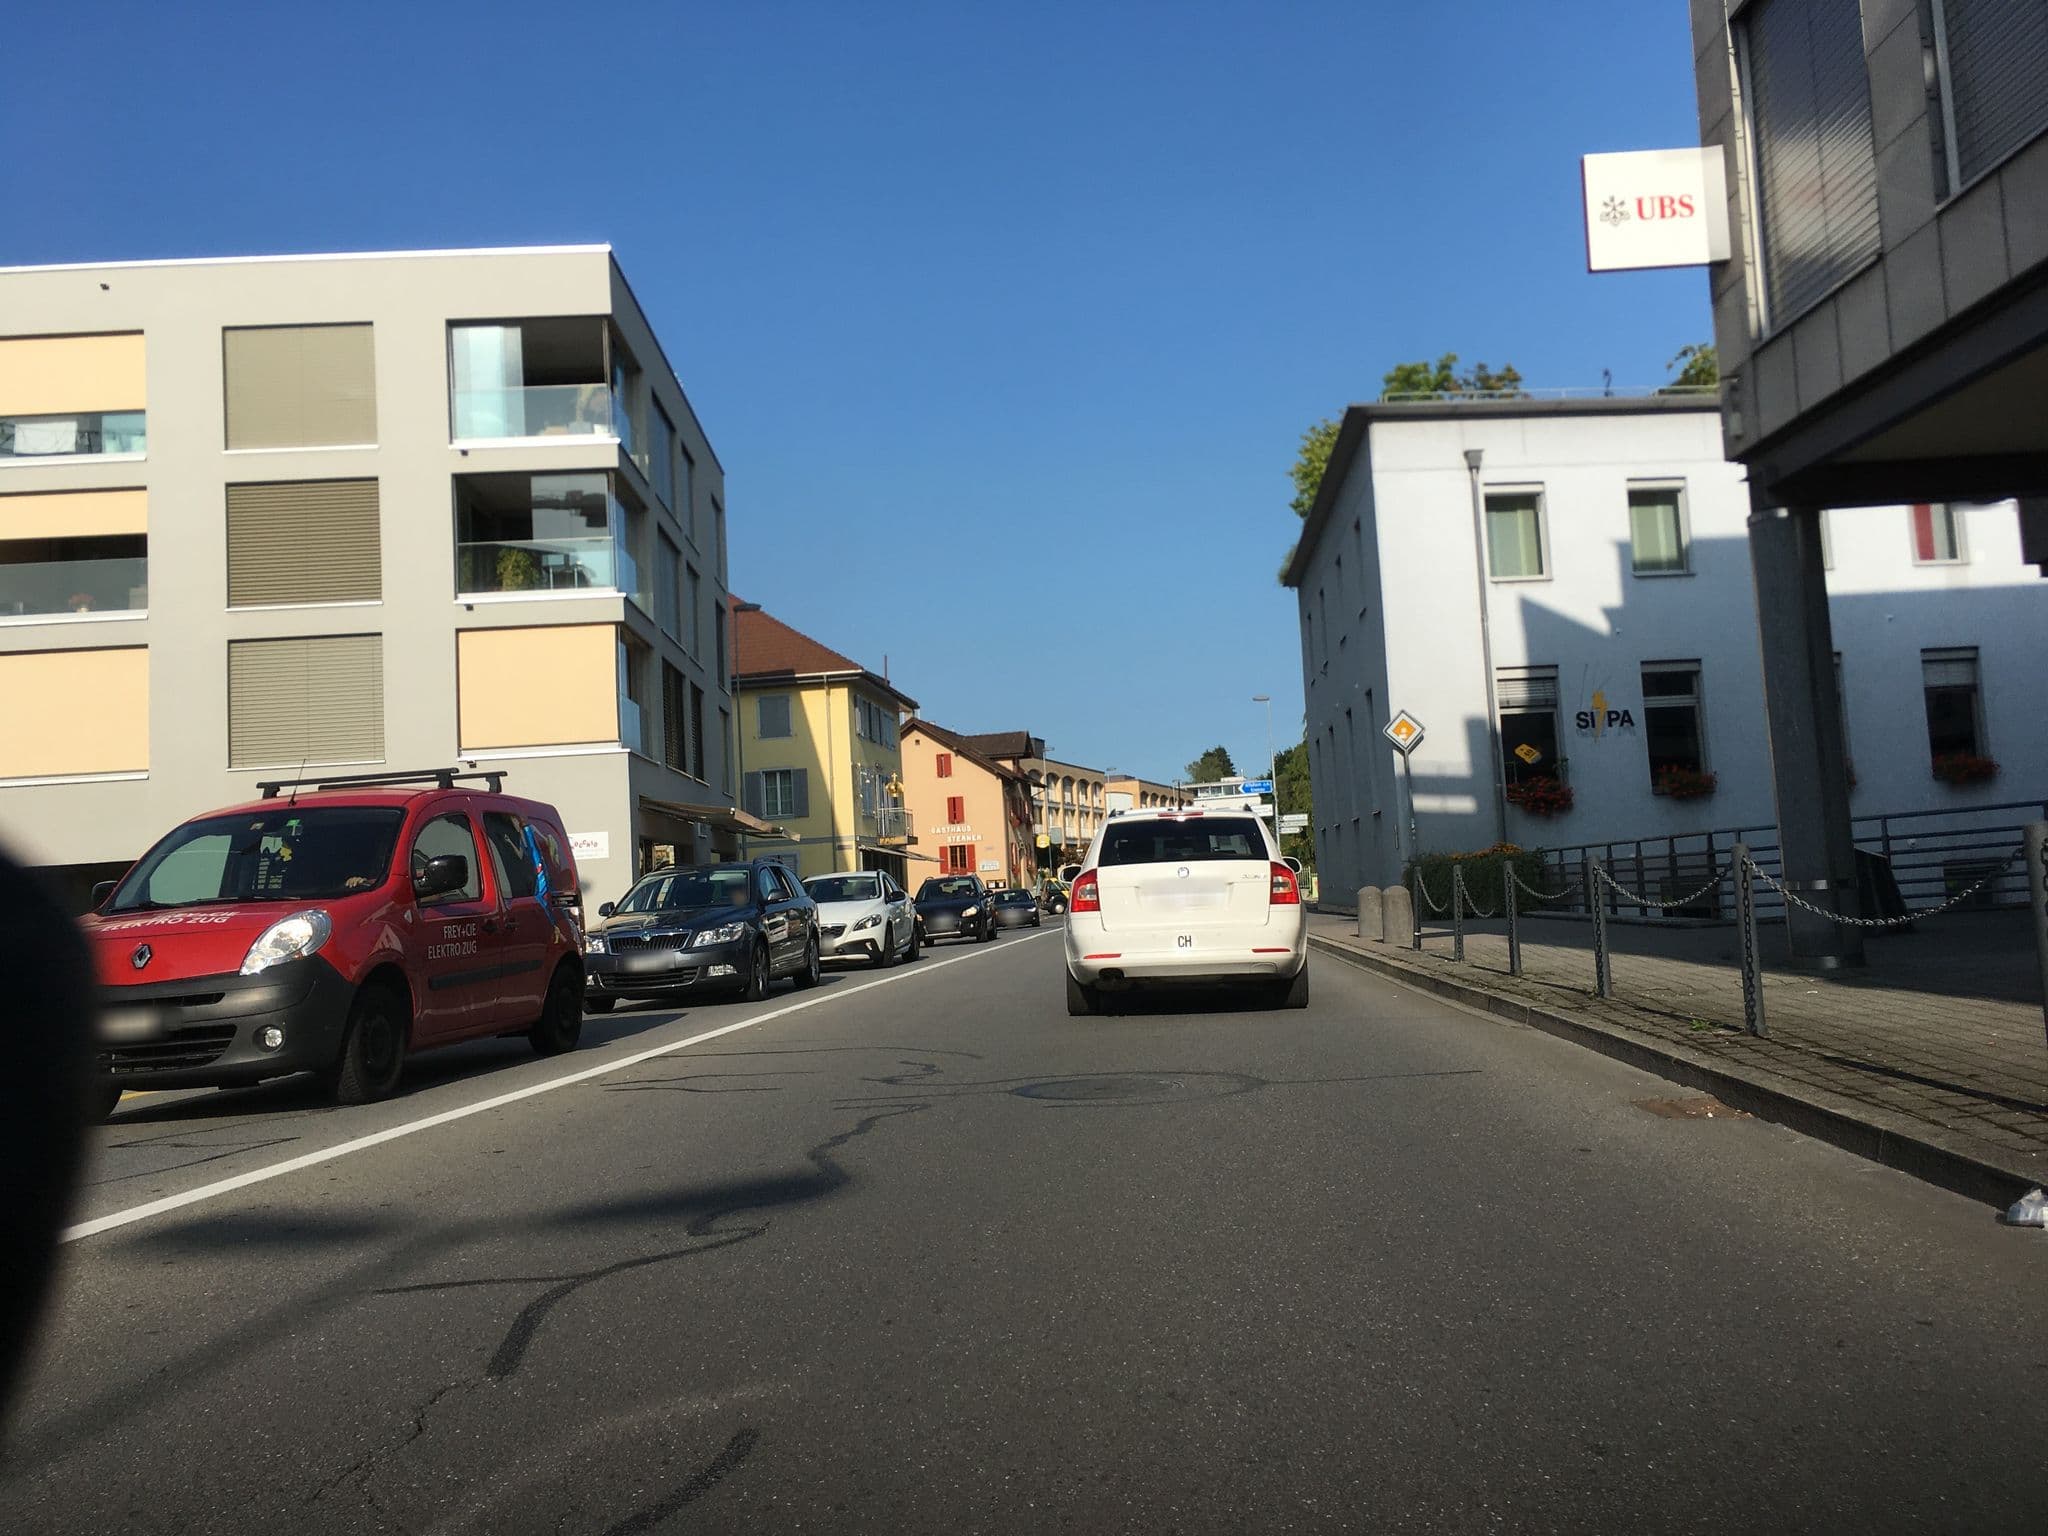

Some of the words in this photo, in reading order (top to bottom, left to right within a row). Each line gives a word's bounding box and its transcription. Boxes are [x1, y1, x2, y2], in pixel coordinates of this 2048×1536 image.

[1635, 193, 1695, 221] UBS
[929, 825, 971, 834] GASTHAUS
[186, 916, 231, 924] ZUG
[443, 923, 477, 939] FREY+CIE
[1177, 935, 1192, 948] CH
[427, 942, 461, 960] ELEKTRO
[462, 940, 477, 955] ZUG
